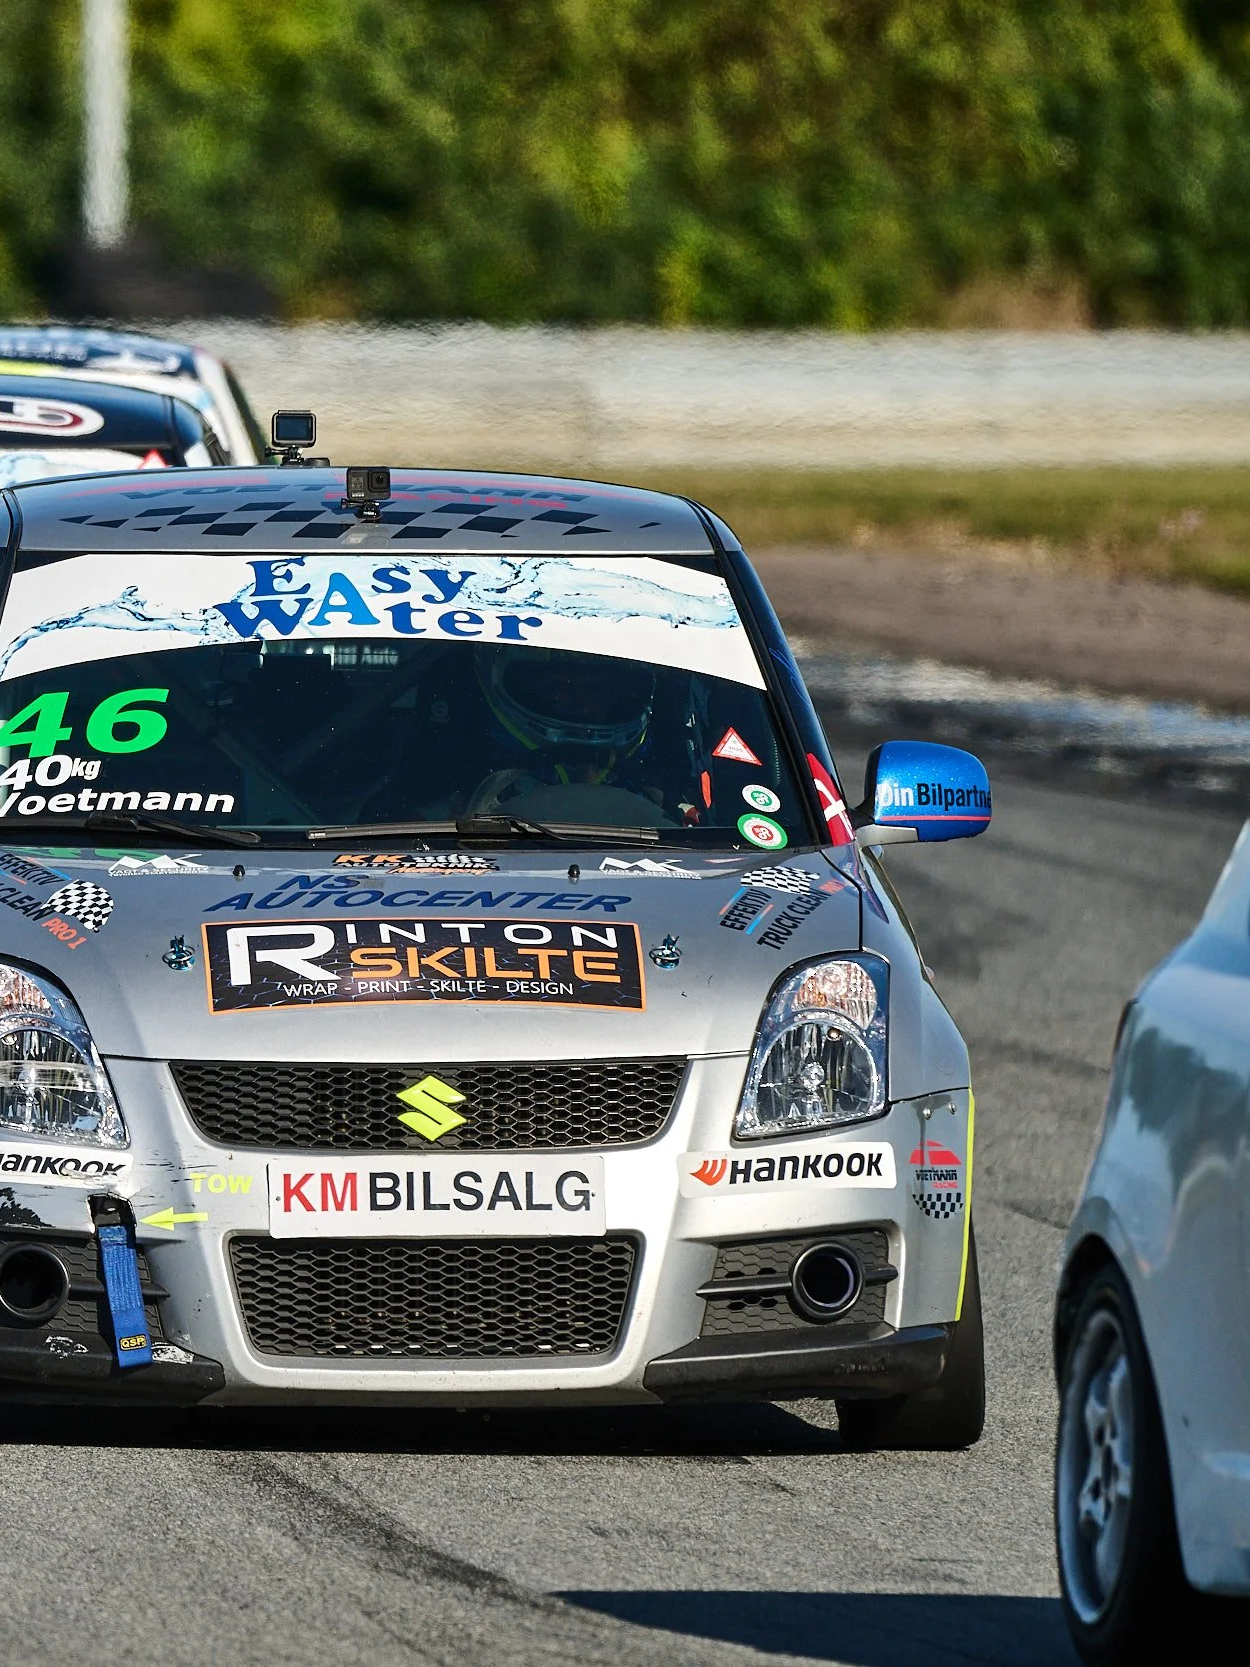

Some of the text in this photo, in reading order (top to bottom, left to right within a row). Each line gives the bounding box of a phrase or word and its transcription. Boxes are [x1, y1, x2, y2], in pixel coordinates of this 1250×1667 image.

[876, 783, 914, 807] Din
[335, 854, 408, 863] KK
[275, 874, 367, 890] NS
[203, 890, 632, 913] AUTOCENTER
[719, 888, 772, 931] EFFEKTIV
[757, 888, 832, 950] TRUCK CLEAN
[350, 947, 621, 983] SKILTE
[283, 982, 337, 996] WRAP
[358, 981, 410, 994] PRINT
[430, 980, 486, 994] SKILTE
[506, 982, 574, 996] DESIGN
[189, 1172, 253, 1194] TOW
[283, 1170, 592, 1213] KM BILSALG
[122, 1336, 145, 1348] QSP
